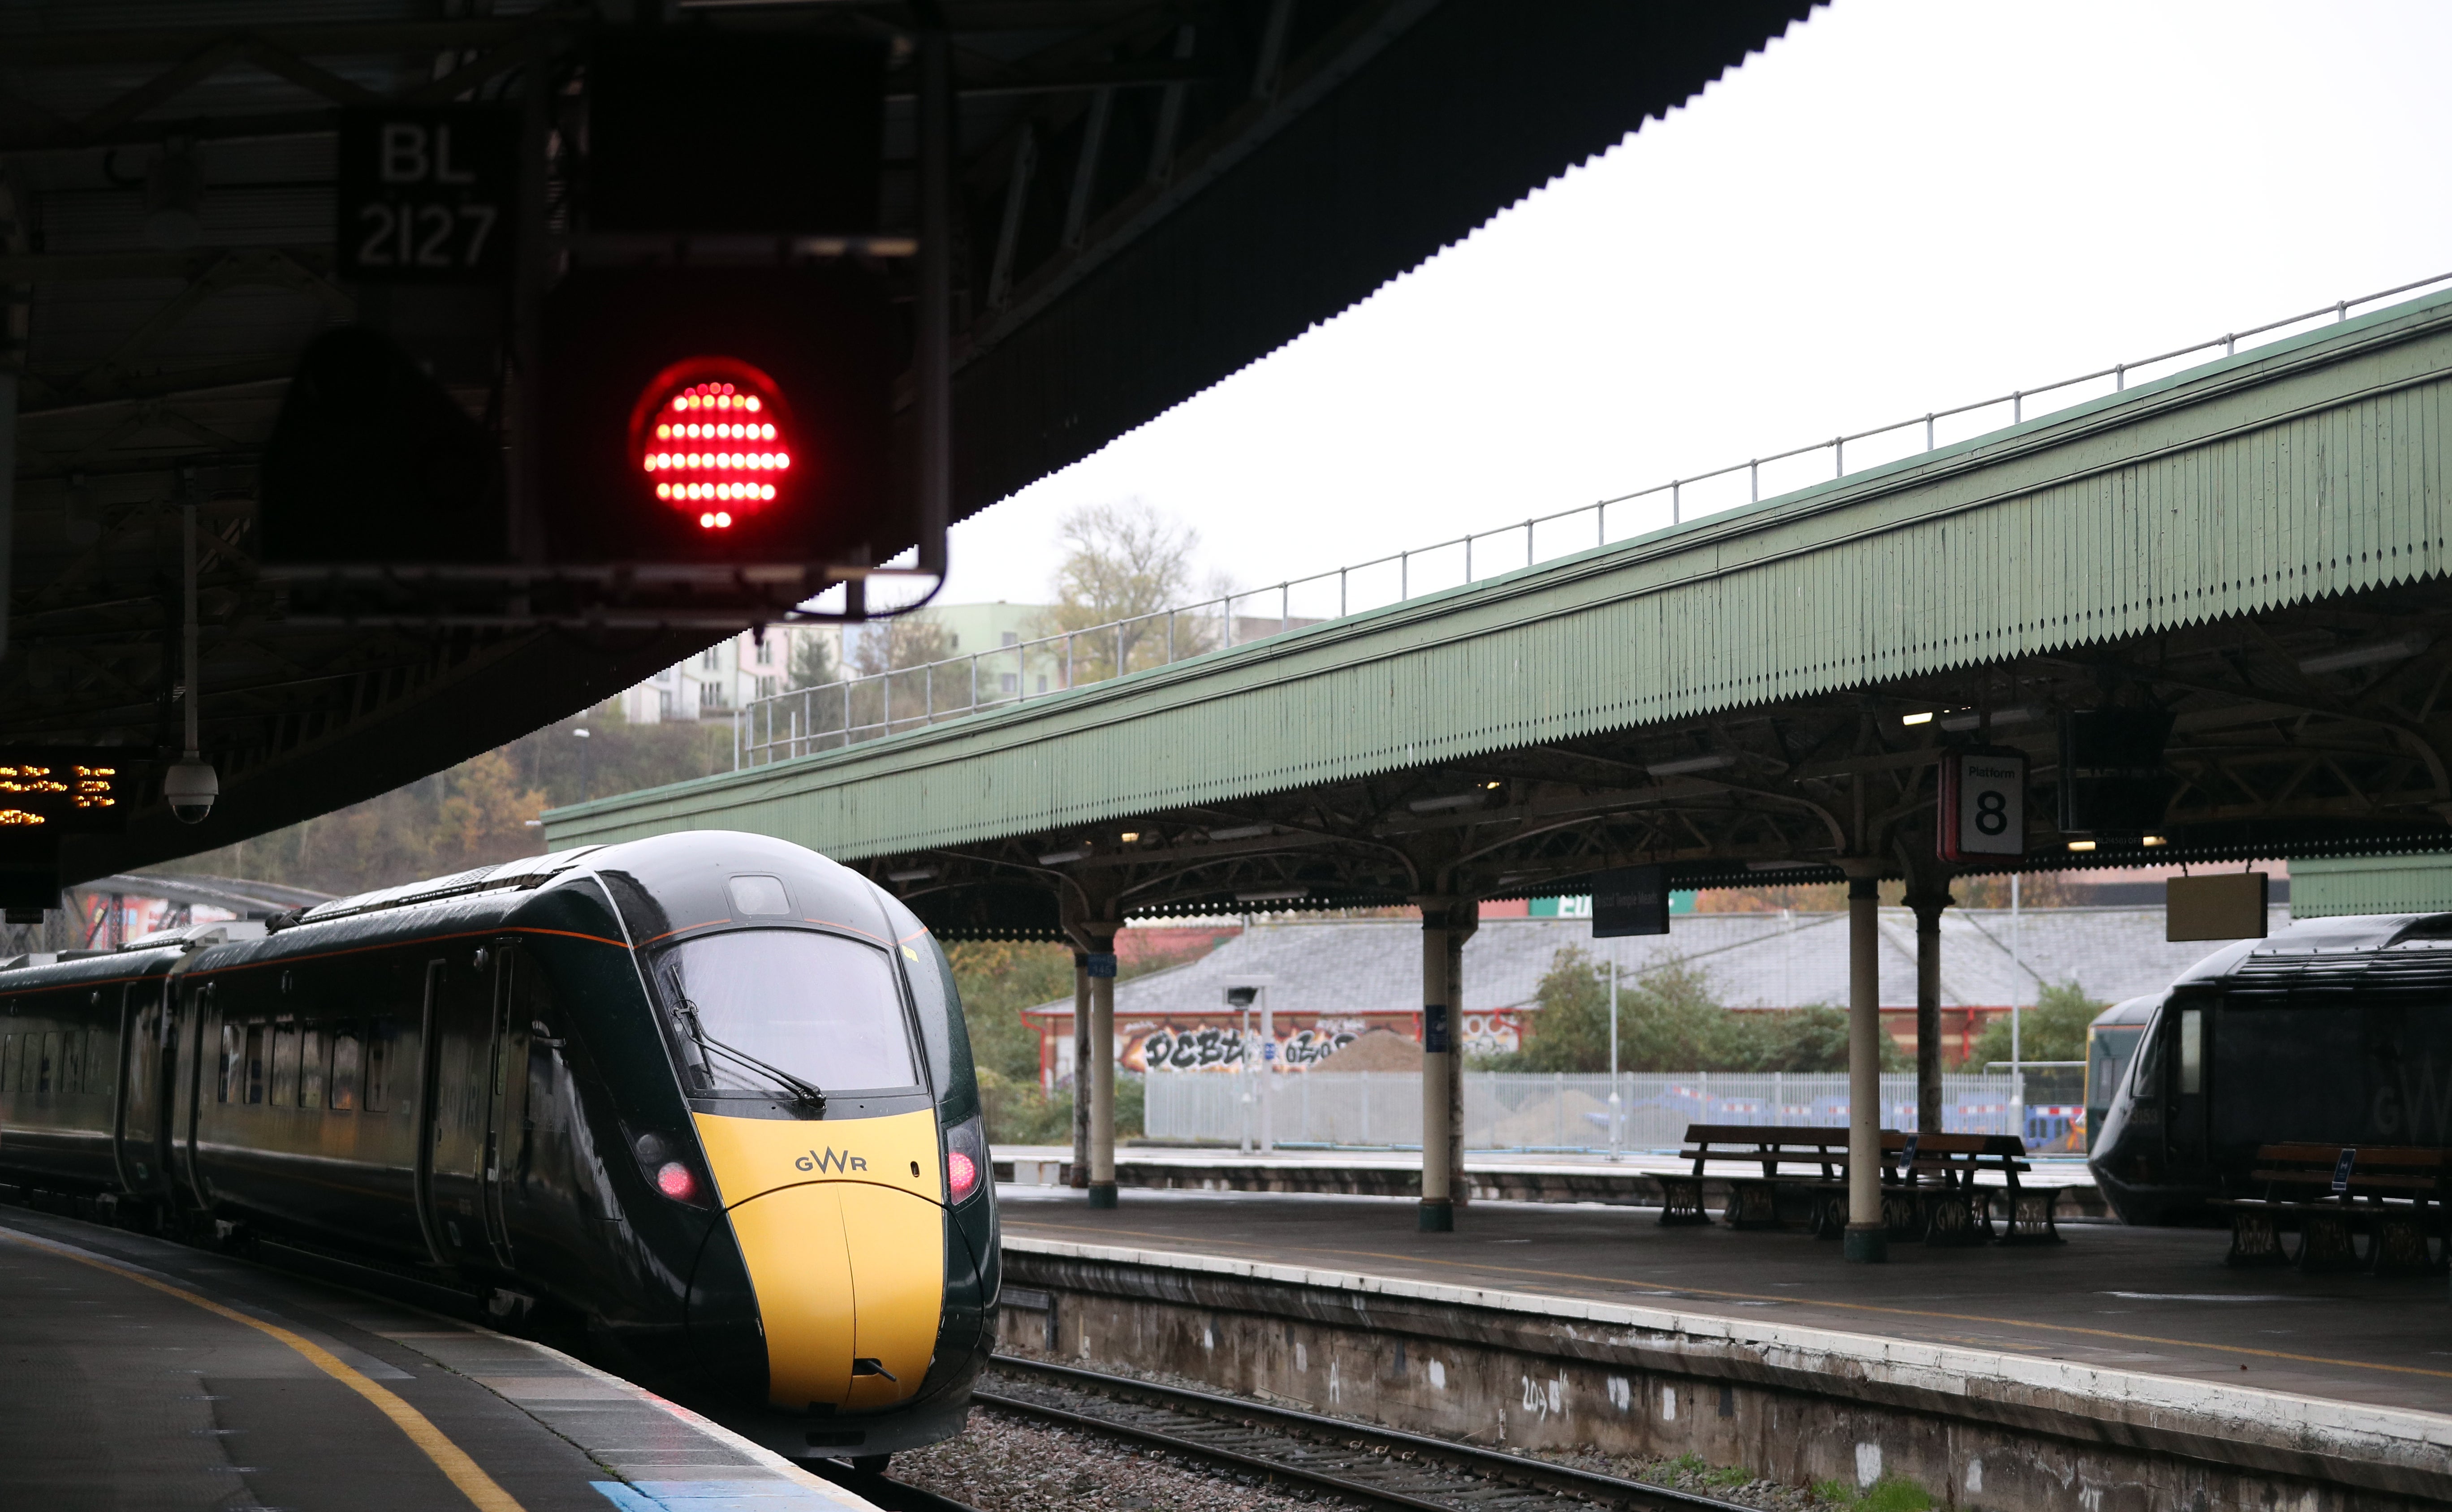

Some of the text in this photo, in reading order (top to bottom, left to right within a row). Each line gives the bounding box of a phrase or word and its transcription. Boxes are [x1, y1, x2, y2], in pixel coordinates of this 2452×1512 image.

[380, 122, 477, 184] BL
[357, 203, 499, 267] 2127
[1969, 767, 2015, 779] Platform
[1975, 790, 2007, 836] 8
[1557, 894, 1593, 918] EU
[1594, 890, 1658, 909] Bristol Temple Meads
[795, 1146, 868, 1175] GWR
[1828, 1198, 1848, 1225] GW
[1936, 1201, 1967, 1230] GWR
